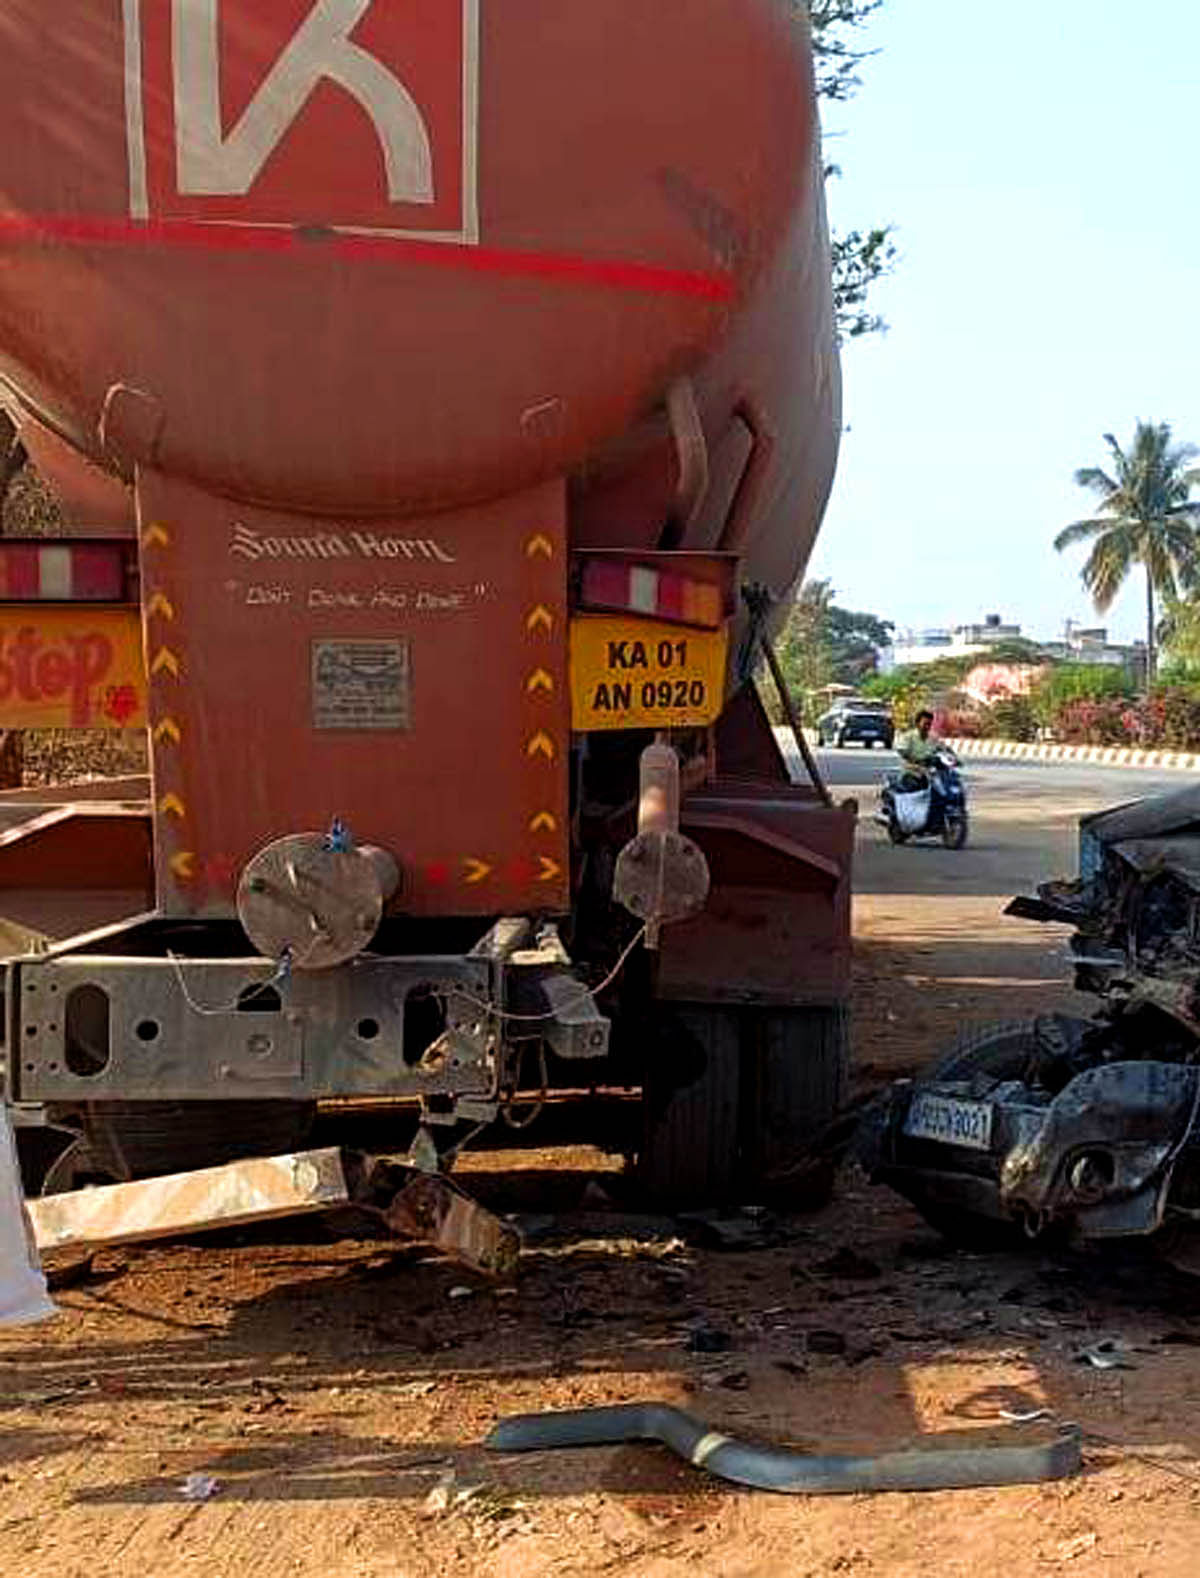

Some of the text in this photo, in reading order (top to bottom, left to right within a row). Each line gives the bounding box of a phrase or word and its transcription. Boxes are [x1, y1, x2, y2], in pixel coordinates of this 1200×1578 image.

[351, 531, 457, 562] Horn
[608, 639, 687, 669] KA 01
[593, 680, 704, 711] AN 0920
